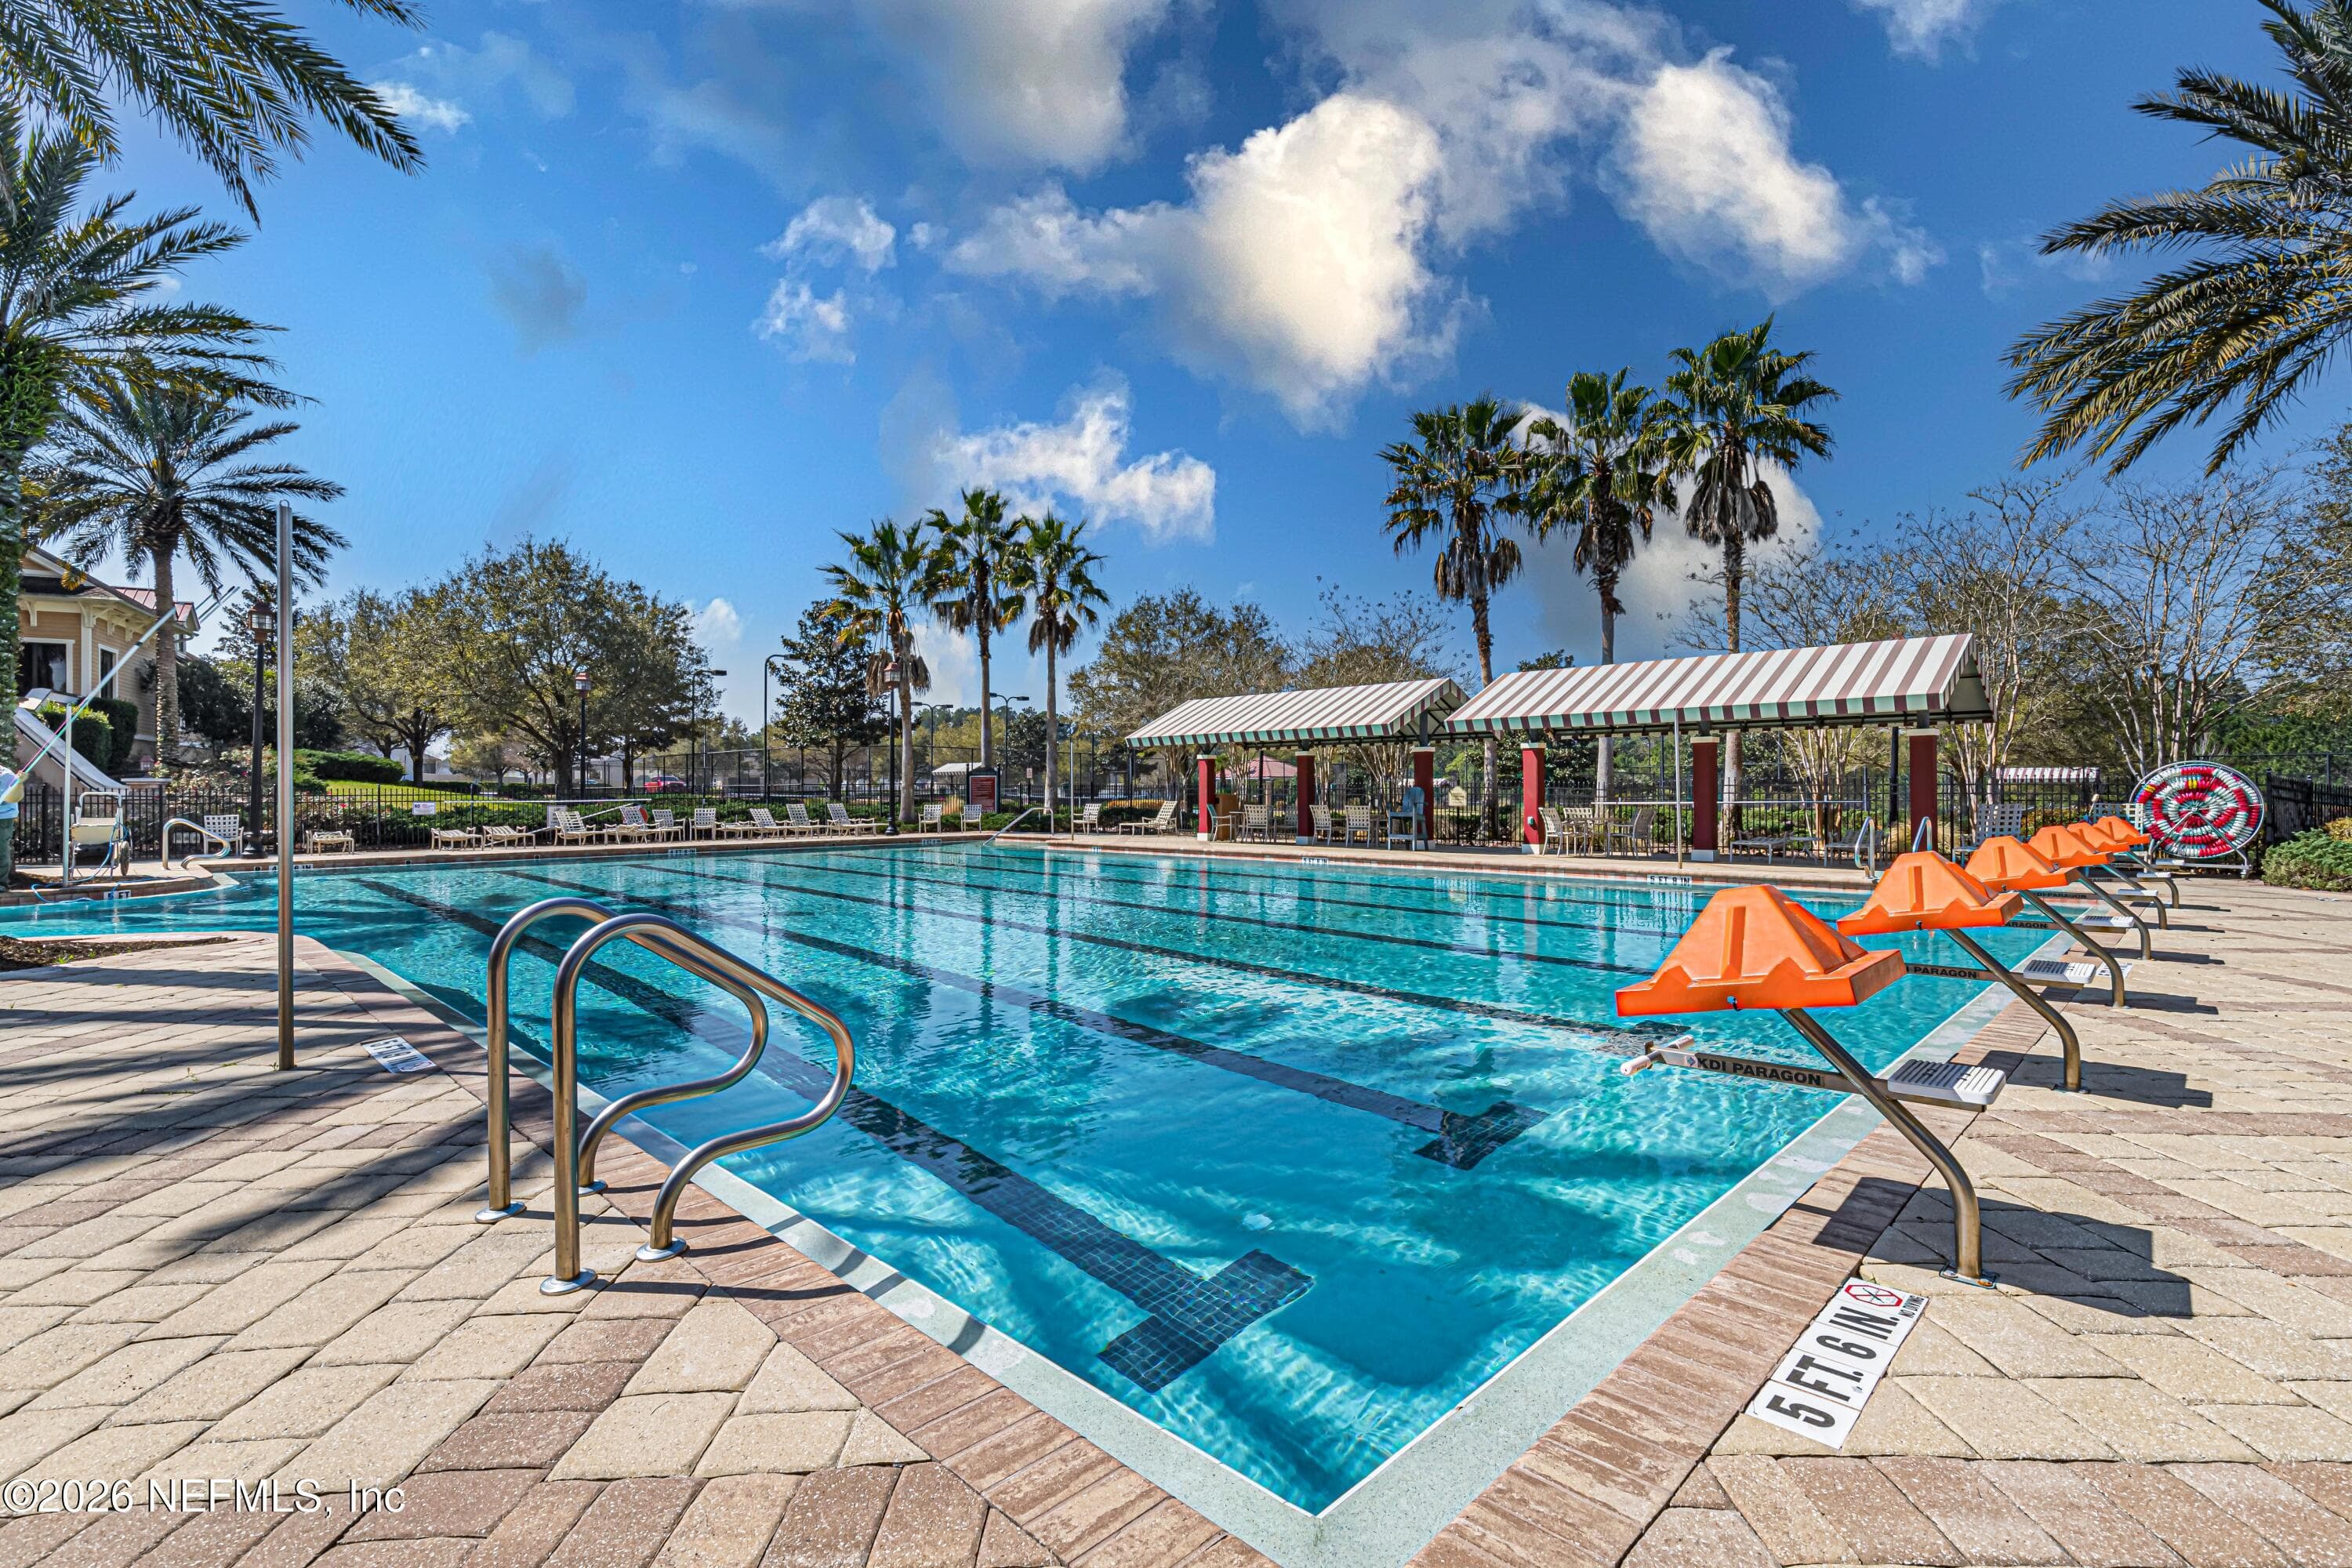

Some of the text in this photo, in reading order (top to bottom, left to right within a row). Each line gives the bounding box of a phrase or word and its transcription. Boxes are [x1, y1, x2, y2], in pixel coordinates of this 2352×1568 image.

[1914, 966, 1976, 979] PARAGON
[1697, 1058, 1821, 1087] KDI PARAGON
[1898, 1294, 1925, 1319] NO DIVING
[1766, 1305, 1900, 1428] 5 FT. 6 IN.
